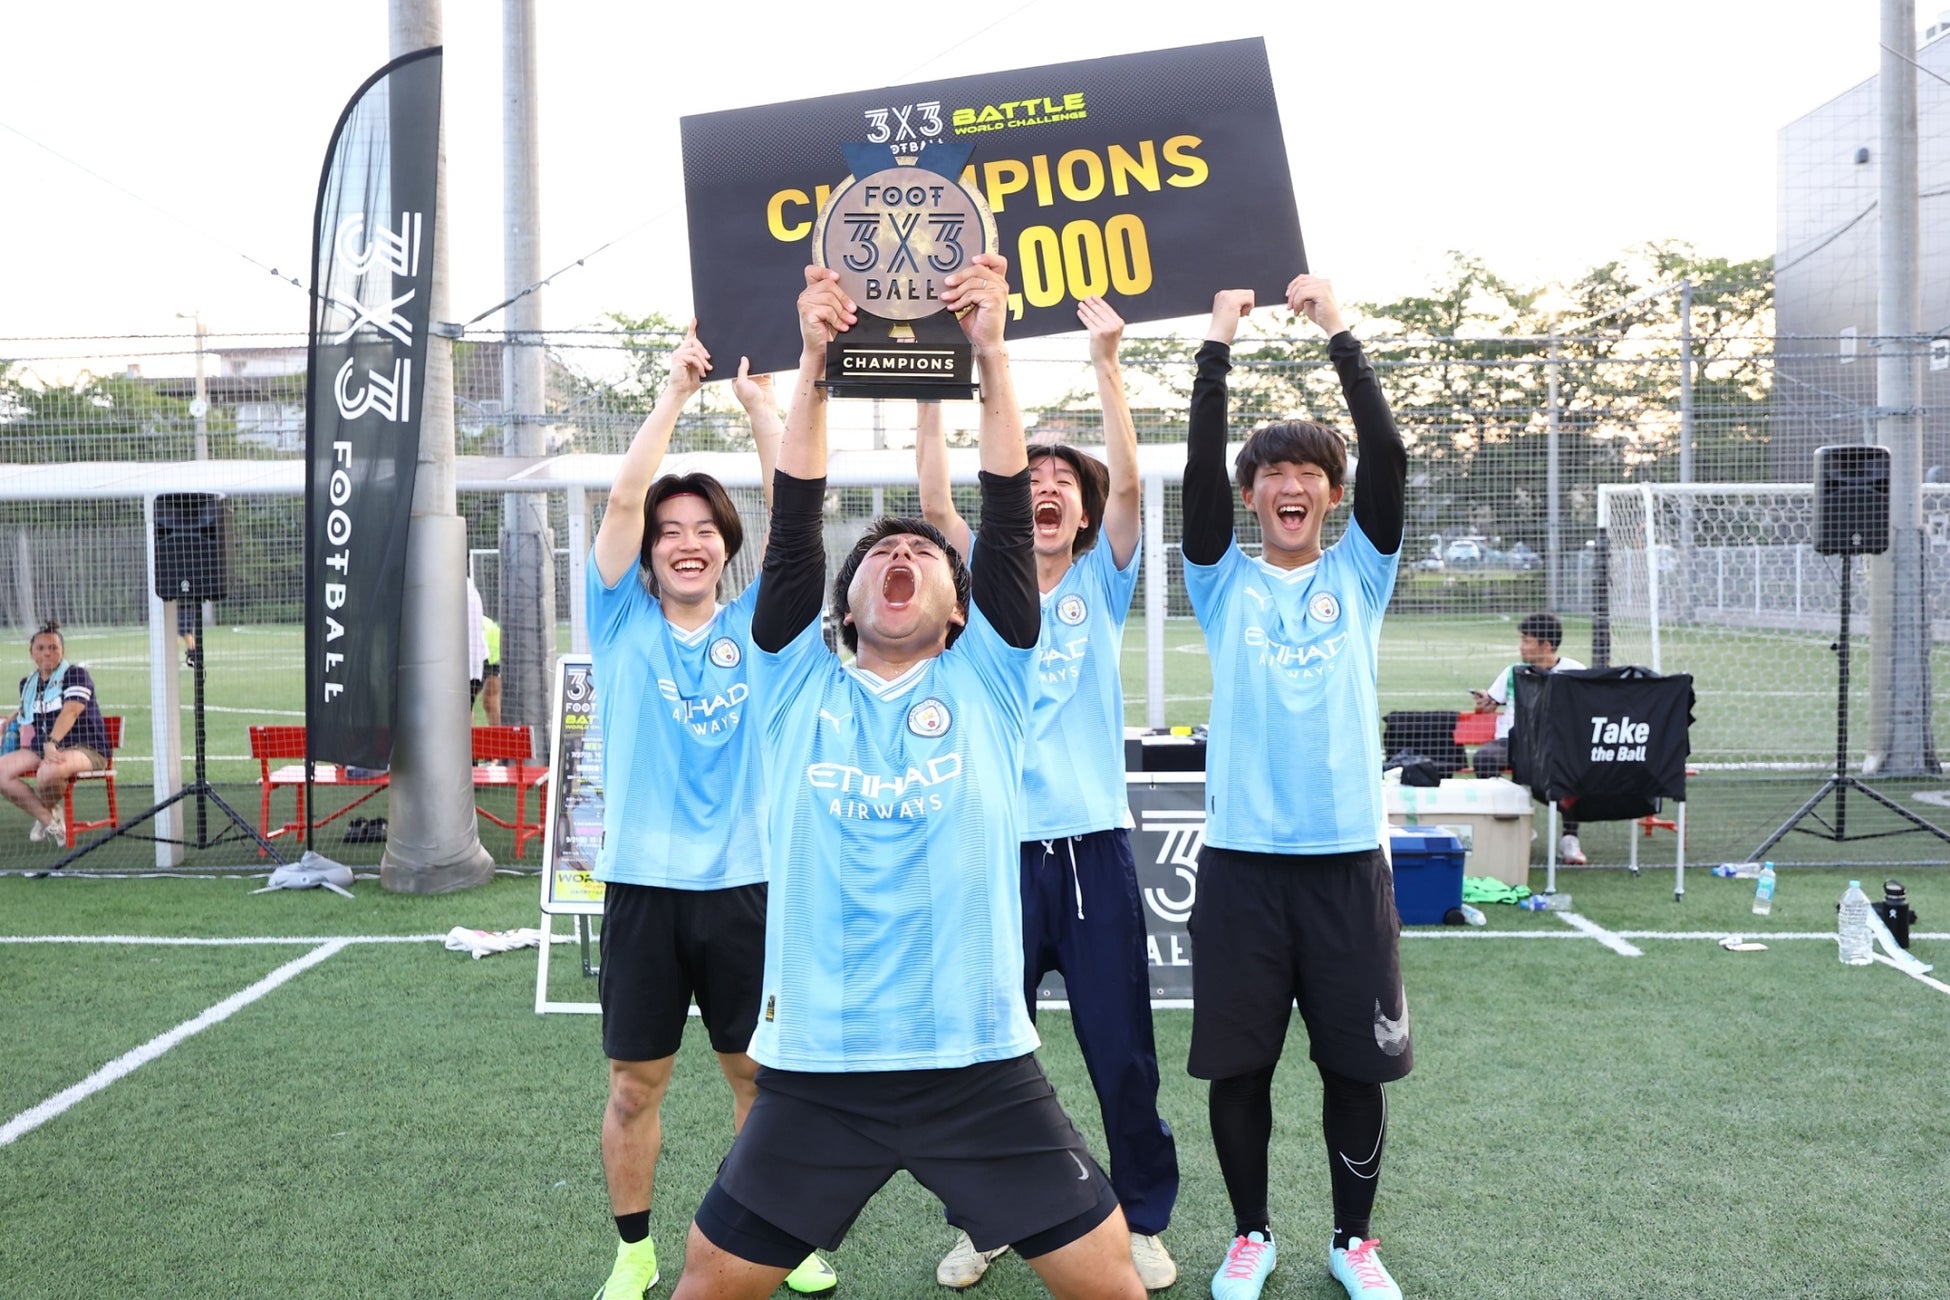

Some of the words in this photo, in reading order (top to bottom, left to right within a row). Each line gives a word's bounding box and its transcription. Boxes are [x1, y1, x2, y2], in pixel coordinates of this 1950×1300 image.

[865, 101, 943, 143] 3X3
[952, 92, 1086, 126] BATTLE
[954, 122, 1004, 135] WORLD
[1007, 110, 1087, 128] CHALLENGE
[864, 186, 945, 207] FOOT
[843, 212, 965, 274] 3X3
[865, 279, 939, 300] BALL
[334, 211, 422, 423] 3X3
[842, 357, 954, 370] CHAMPIONS
[324, 440, 352, 703] FOOTBALL
[672, 708, 740, 736] AIWAYS
[1591, 716, 1650, 744] Take
[1590, 746, 1615, 762] the
[1616, 746, 1647, 762] Ball
[807, 752, 962, 798] ETIHAD
[829, 793, 943, 820] AIRWAYS
